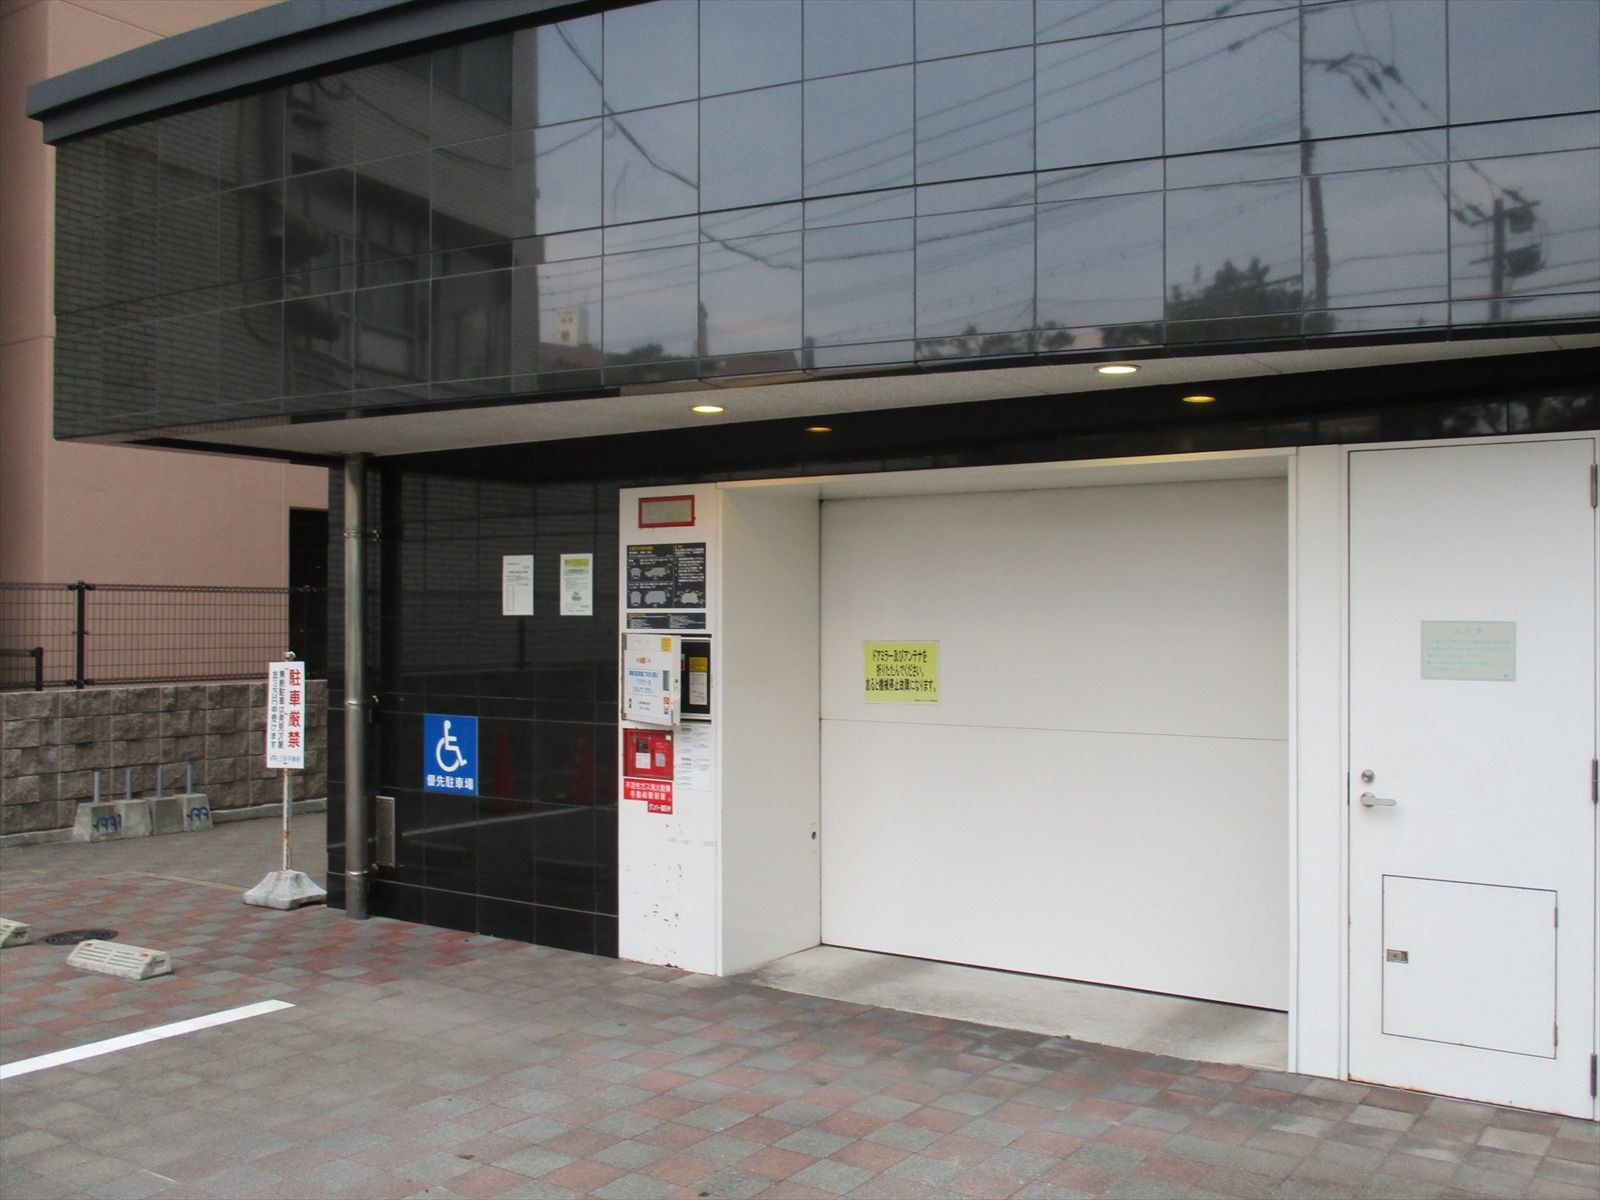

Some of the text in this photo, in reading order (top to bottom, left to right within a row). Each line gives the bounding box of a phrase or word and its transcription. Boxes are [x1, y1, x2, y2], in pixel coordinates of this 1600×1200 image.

[872, 649, 928, 663] ドアミラー及びアンテナを
[876, 664, 925, 677] 折りたたんでください。
[288, 668, 302, 749] 駐車厳禁
[426, 774, 475, 791] 優先駐車場
